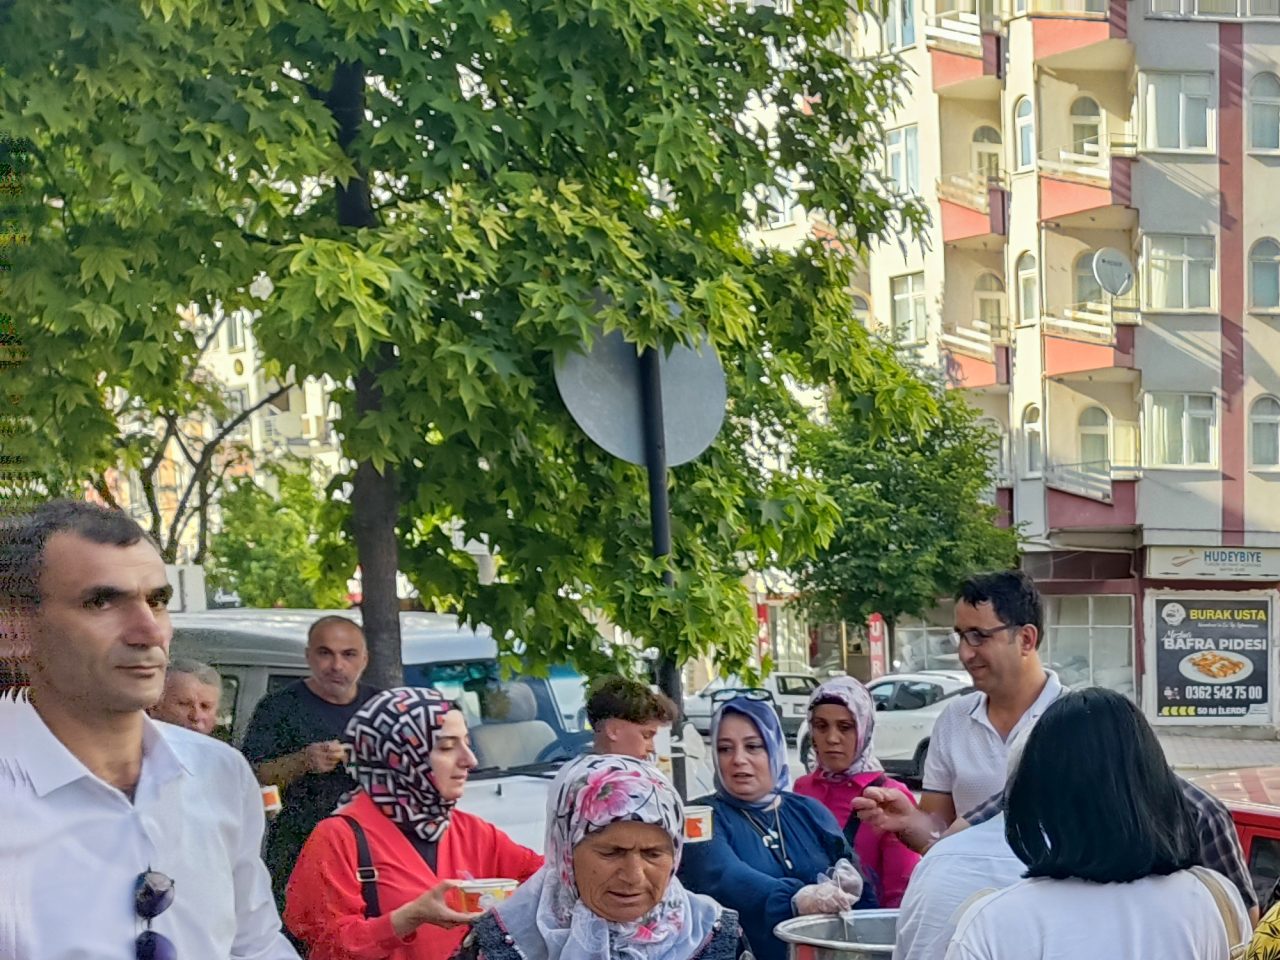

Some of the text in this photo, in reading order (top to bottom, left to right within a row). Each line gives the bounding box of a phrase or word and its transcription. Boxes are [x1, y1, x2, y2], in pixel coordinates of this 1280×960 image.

[1189, 609, 1267, 621] BURAK USTA
[1163, 638, 1217, 650] BAFRA
[1185, 685, 1263, 700] 0362 542 75 00
[1196, 706, 1208, 715] 50
